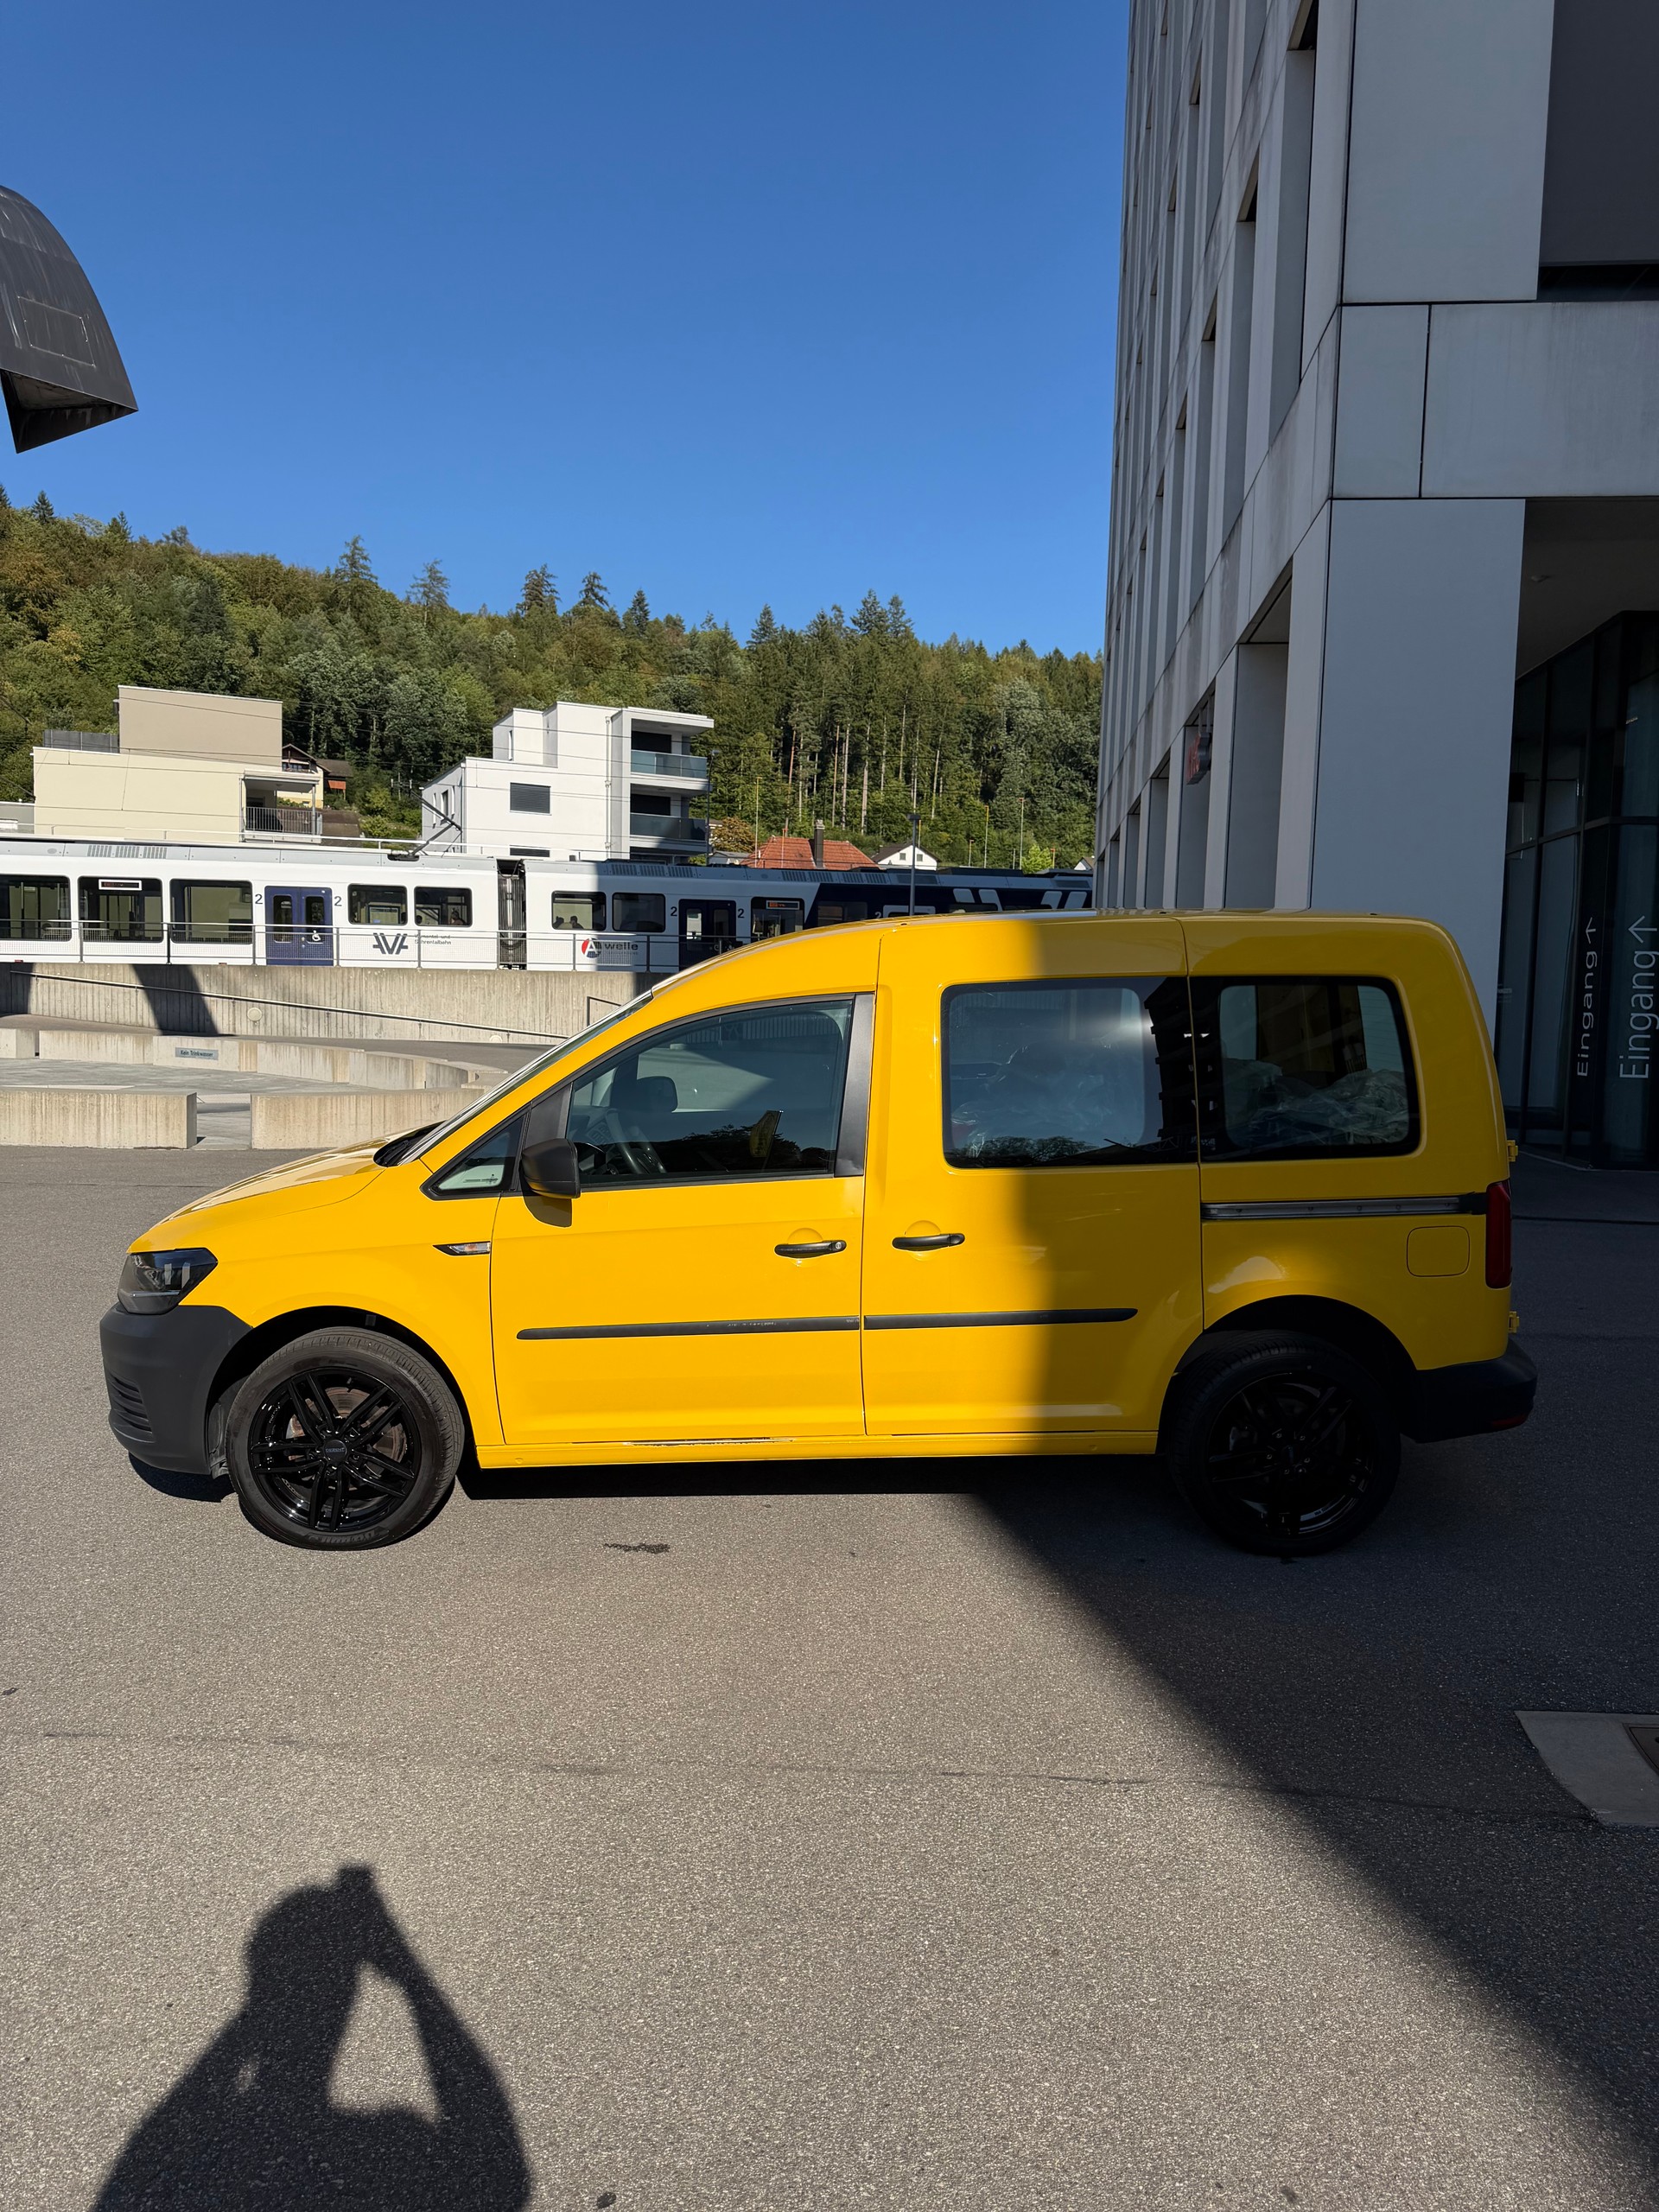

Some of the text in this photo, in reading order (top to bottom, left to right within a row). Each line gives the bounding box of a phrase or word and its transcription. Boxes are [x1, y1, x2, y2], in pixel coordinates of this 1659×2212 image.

[255, 894, 263, 904] 2
[334, 896, 342, 906] 2
[671, 906, 677, 916] 2
[737, 908, 745, 918] 2
[1577, 951, 1598, 1077] Eingang
[1619, 951, 1659, 1078] Eingang
